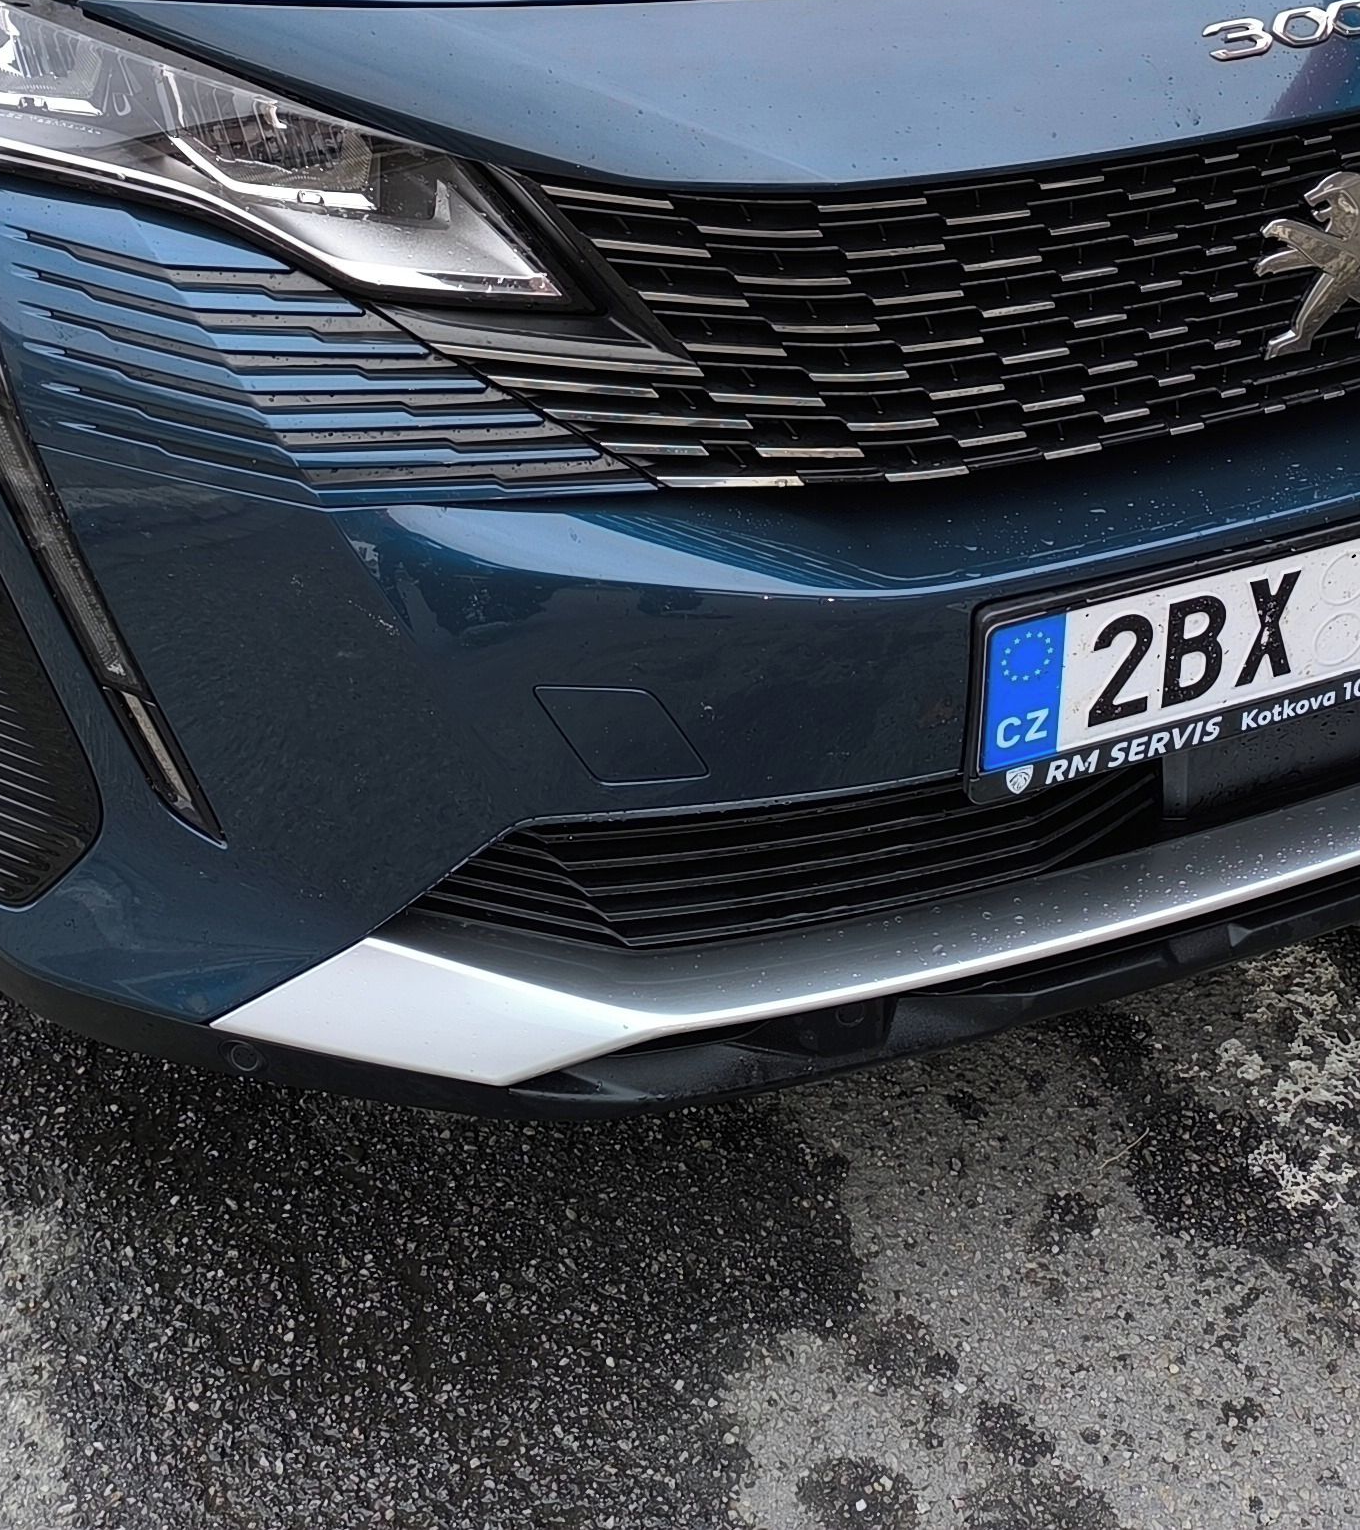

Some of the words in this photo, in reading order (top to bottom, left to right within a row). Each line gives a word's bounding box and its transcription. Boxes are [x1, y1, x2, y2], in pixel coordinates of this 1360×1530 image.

[1087, 569, 1302, 728] 2BX
[996, 708, 1049, 749] CZ
[1044, 753, 1100, 786] RM
[1107, 716, 1223, 769] SERVIS
[1240, 690, 1336, 731] Kotkova
